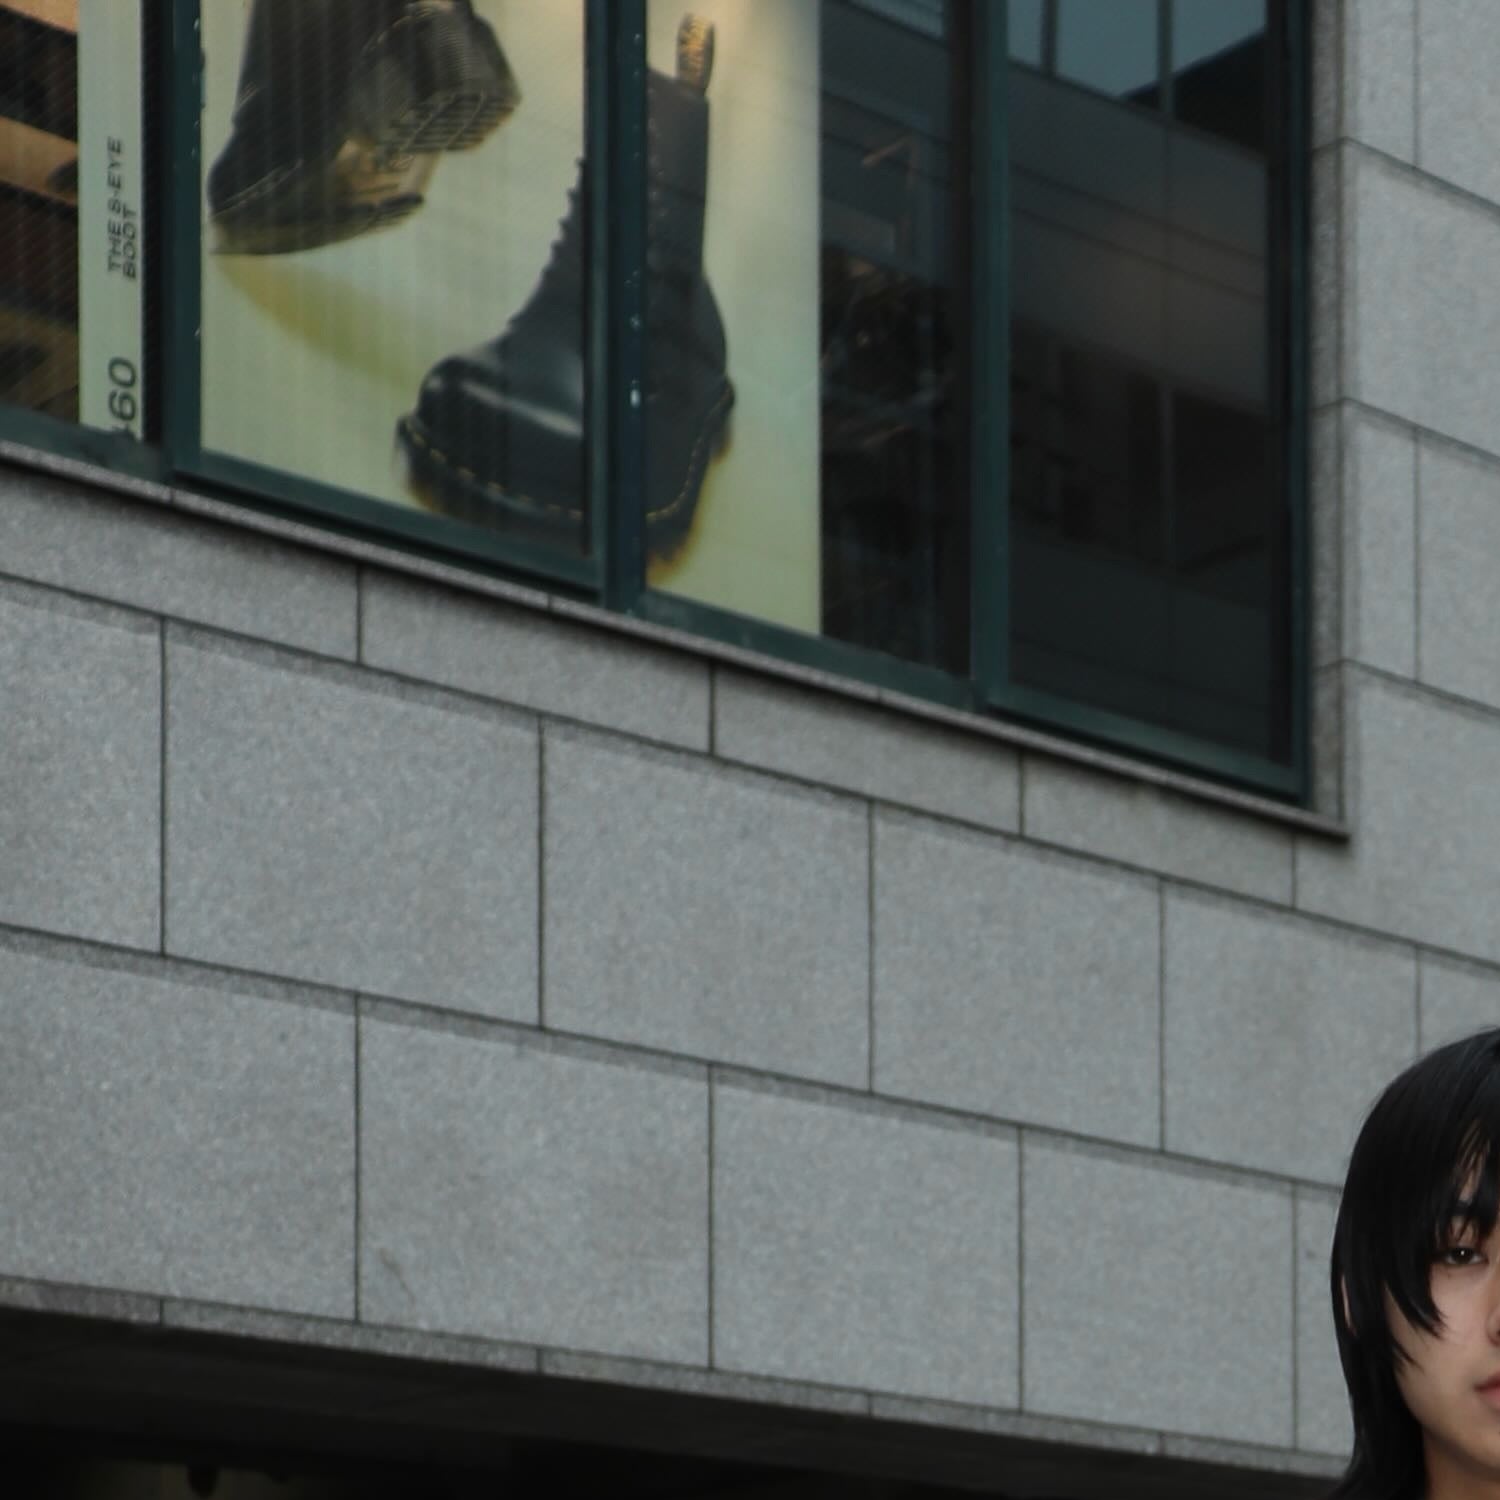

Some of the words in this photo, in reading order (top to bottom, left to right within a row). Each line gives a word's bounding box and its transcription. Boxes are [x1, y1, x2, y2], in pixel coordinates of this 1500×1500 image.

[107, 220, 122, 273] THE
[122, 204, 137, 279] BOOT
[108, 356, 136, 430] 60
